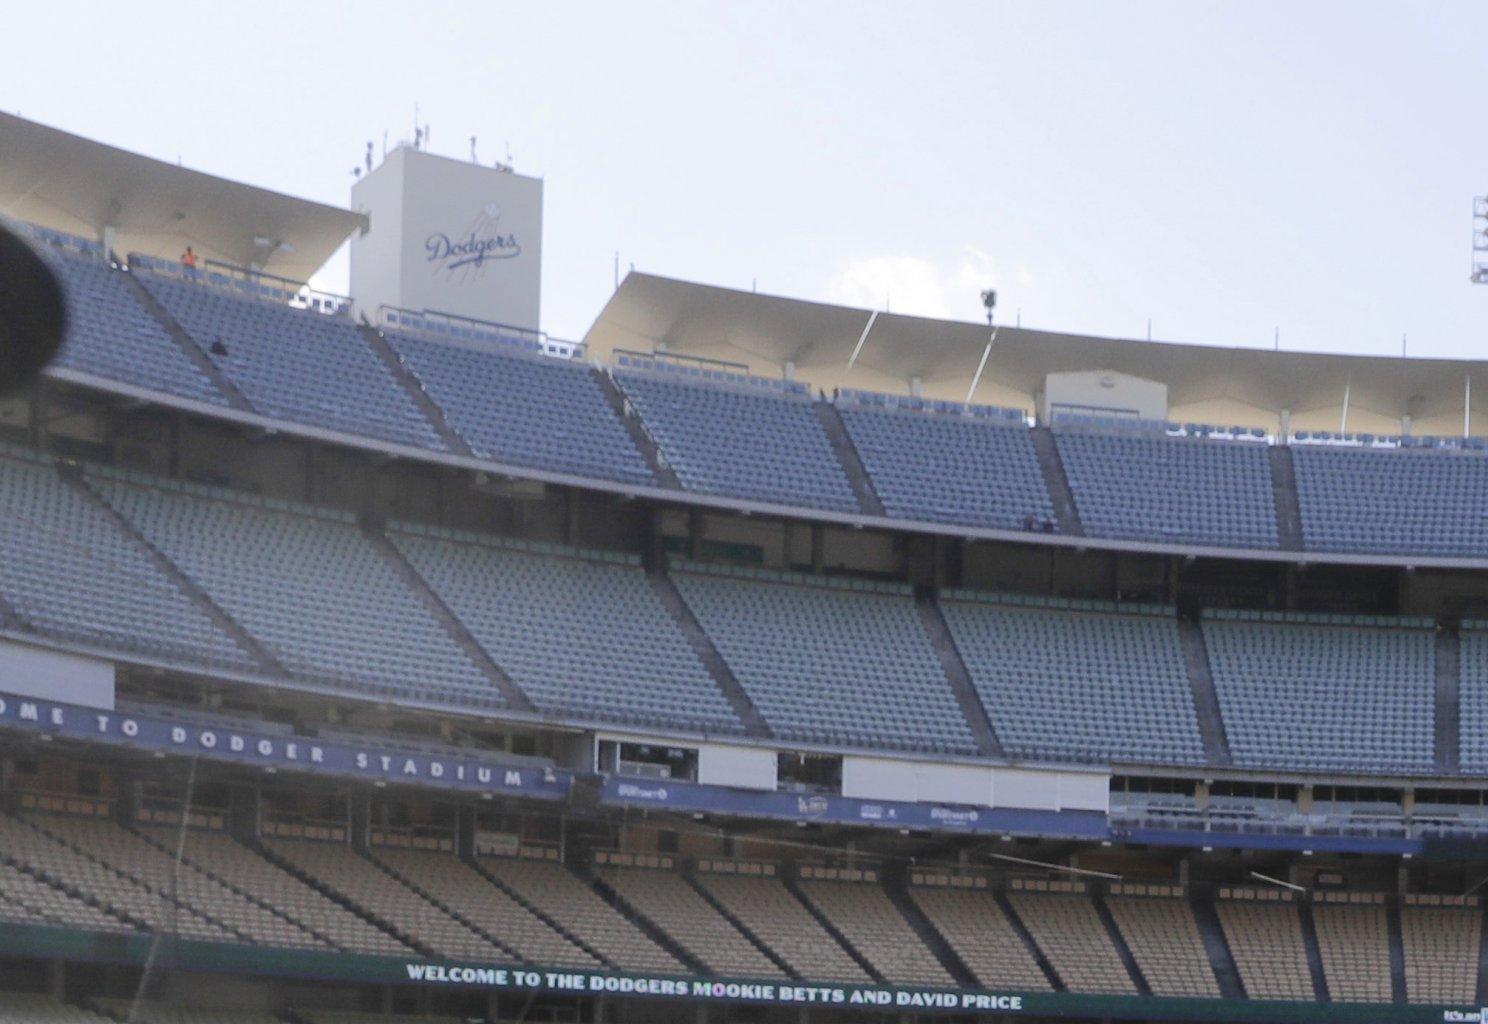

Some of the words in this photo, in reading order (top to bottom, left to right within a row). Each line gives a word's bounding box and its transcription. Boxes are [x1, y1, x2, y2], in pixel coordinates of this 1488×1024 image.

[425, 232, 521, 270] Dodgers
[97, 715, 139, 737] TO
[172, 726, 323, 763] DODGER
[356, 752, 522, 786] STADIUM
[406, 963, 508, 985] WELCOME
[512, 971, 541, 987] TO
[546, 972, 586, 990] THE
[589, 975, 688, 995] DODGERS
[693, 981, 774, 1000] MOOKIE
[779, 985, 845, 1003] BETTS
[850, 990, 892, 1006] AND
[896, 991, 958, 1008] DAVID
[962, 994, 1023, 1010] PRICE
